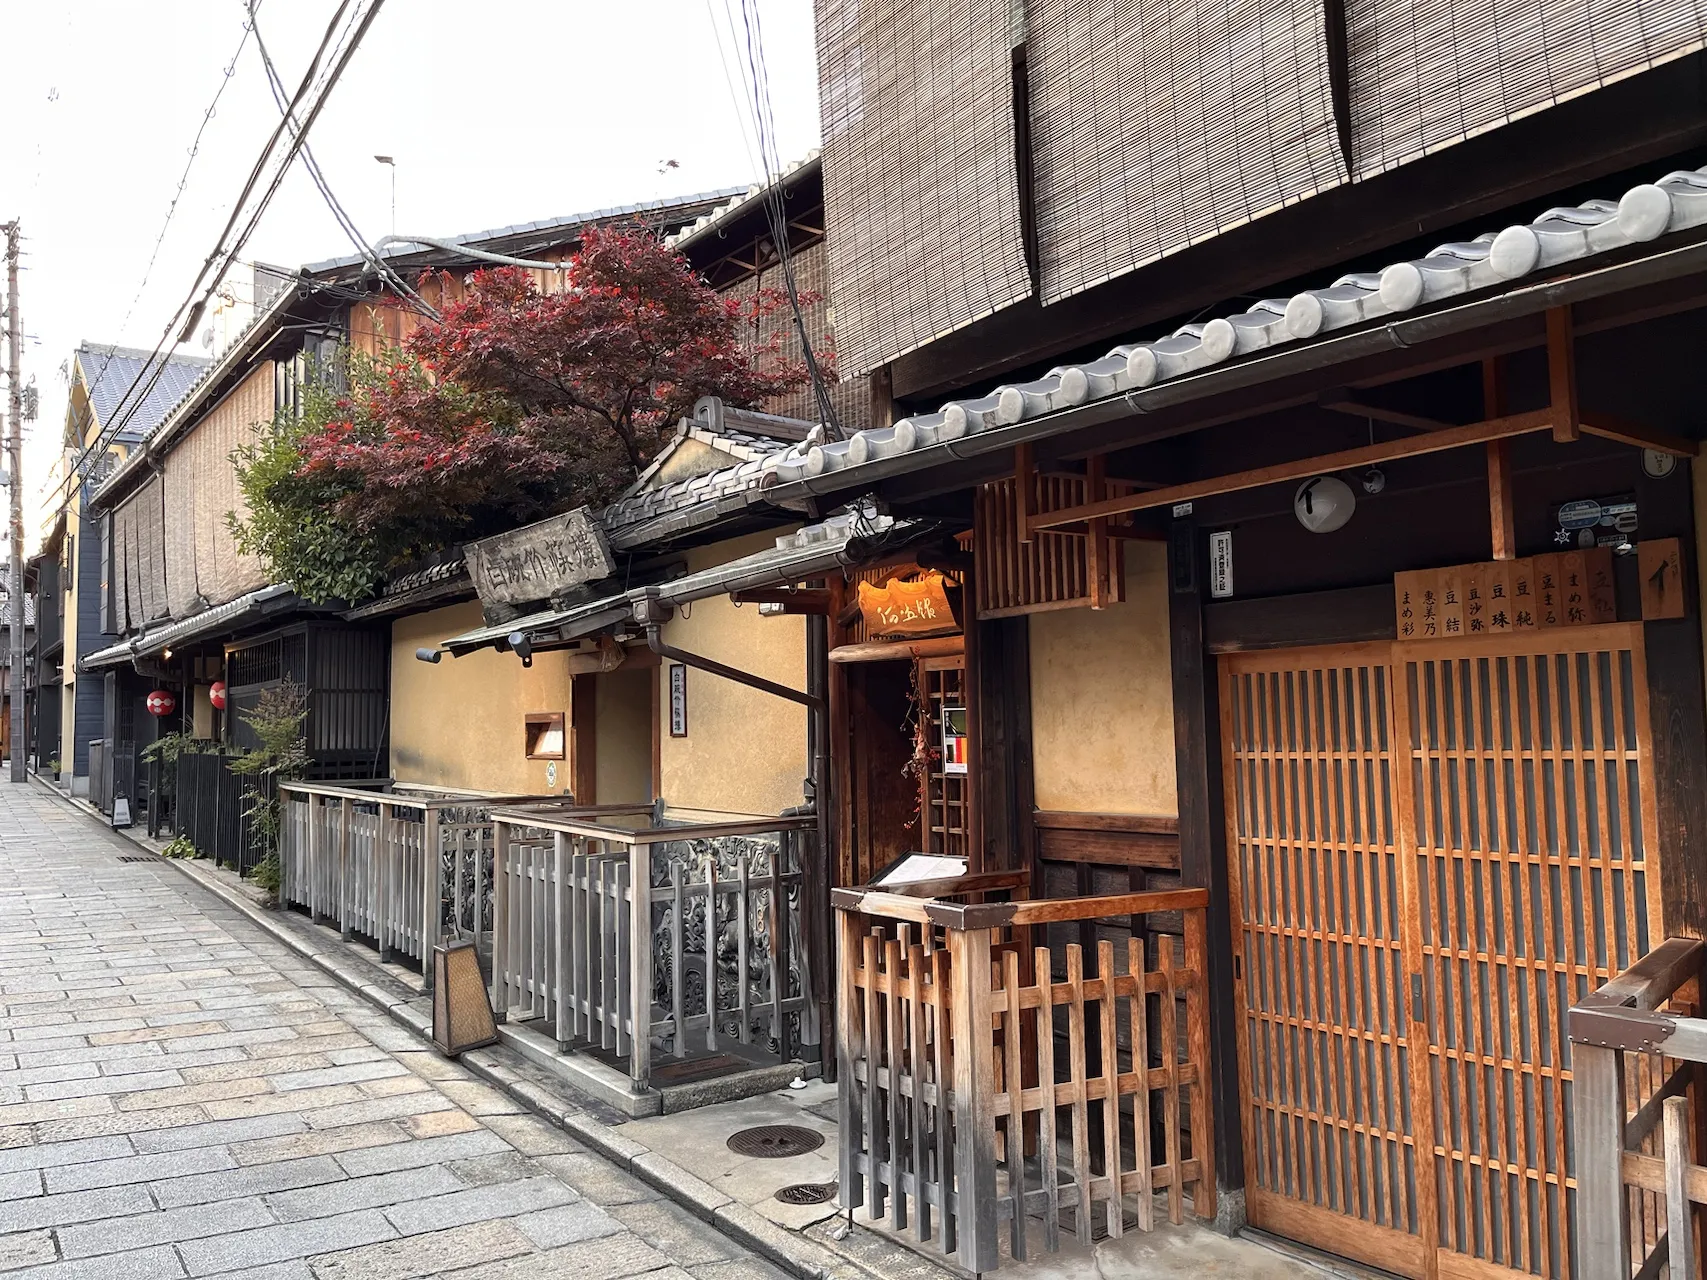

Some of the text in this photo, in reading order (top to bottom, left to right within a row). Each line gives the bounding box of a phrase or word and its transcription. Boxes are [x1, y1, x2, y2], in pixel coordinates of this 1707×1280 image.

[1401, 591, 1415, 637] まめ彩
[1444, 590, 1460, 633] 豆結
[1468, 587, 1485, 632] 豆沙弥
[1491, 584, 1511, 629] 豆珠
[1516, 581, 1534, 627] 豆純
[1542, 574, 1556, 624] 豆まる
